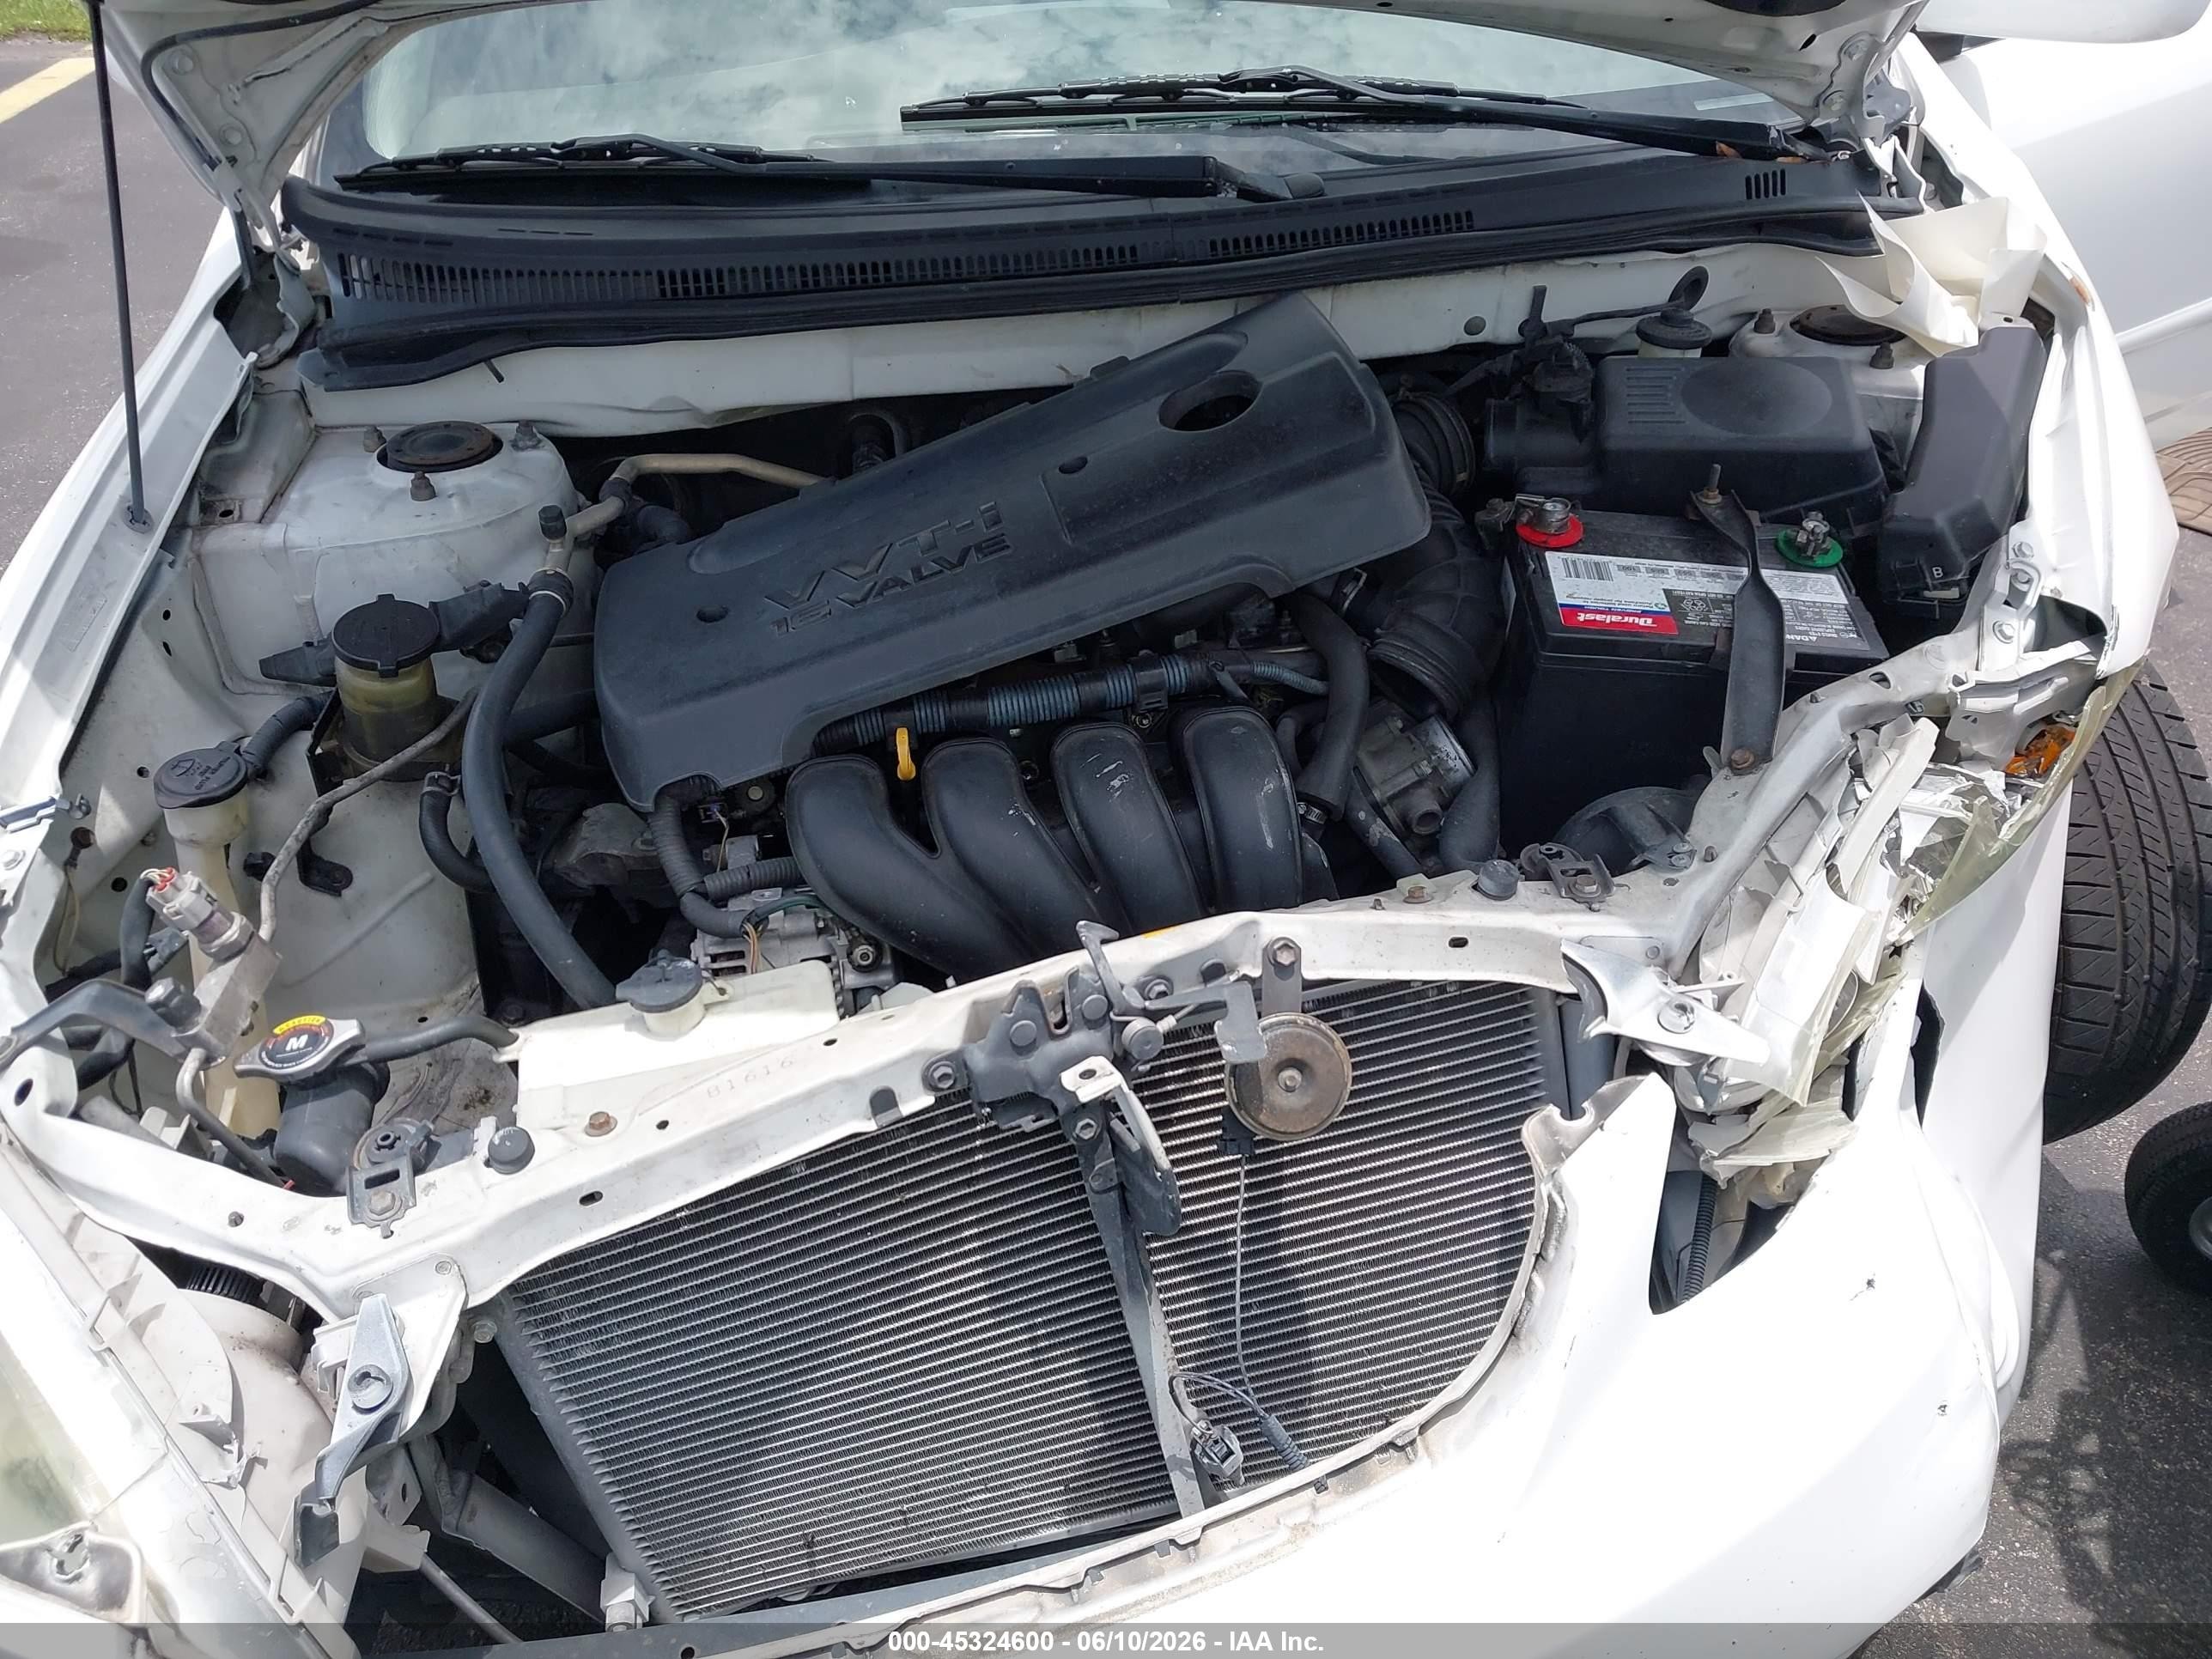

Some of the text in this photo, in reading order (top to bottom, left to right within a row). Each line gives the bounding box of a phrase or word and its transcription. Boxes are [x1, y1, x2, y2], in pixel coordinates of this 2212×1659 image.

[1932, 567, 1943, 578] B
[770, 532, 1014, 636] 16 VALVE
[1577, 612, 1658, 627] Duralast
[285, 1034, 309, 1052] M
